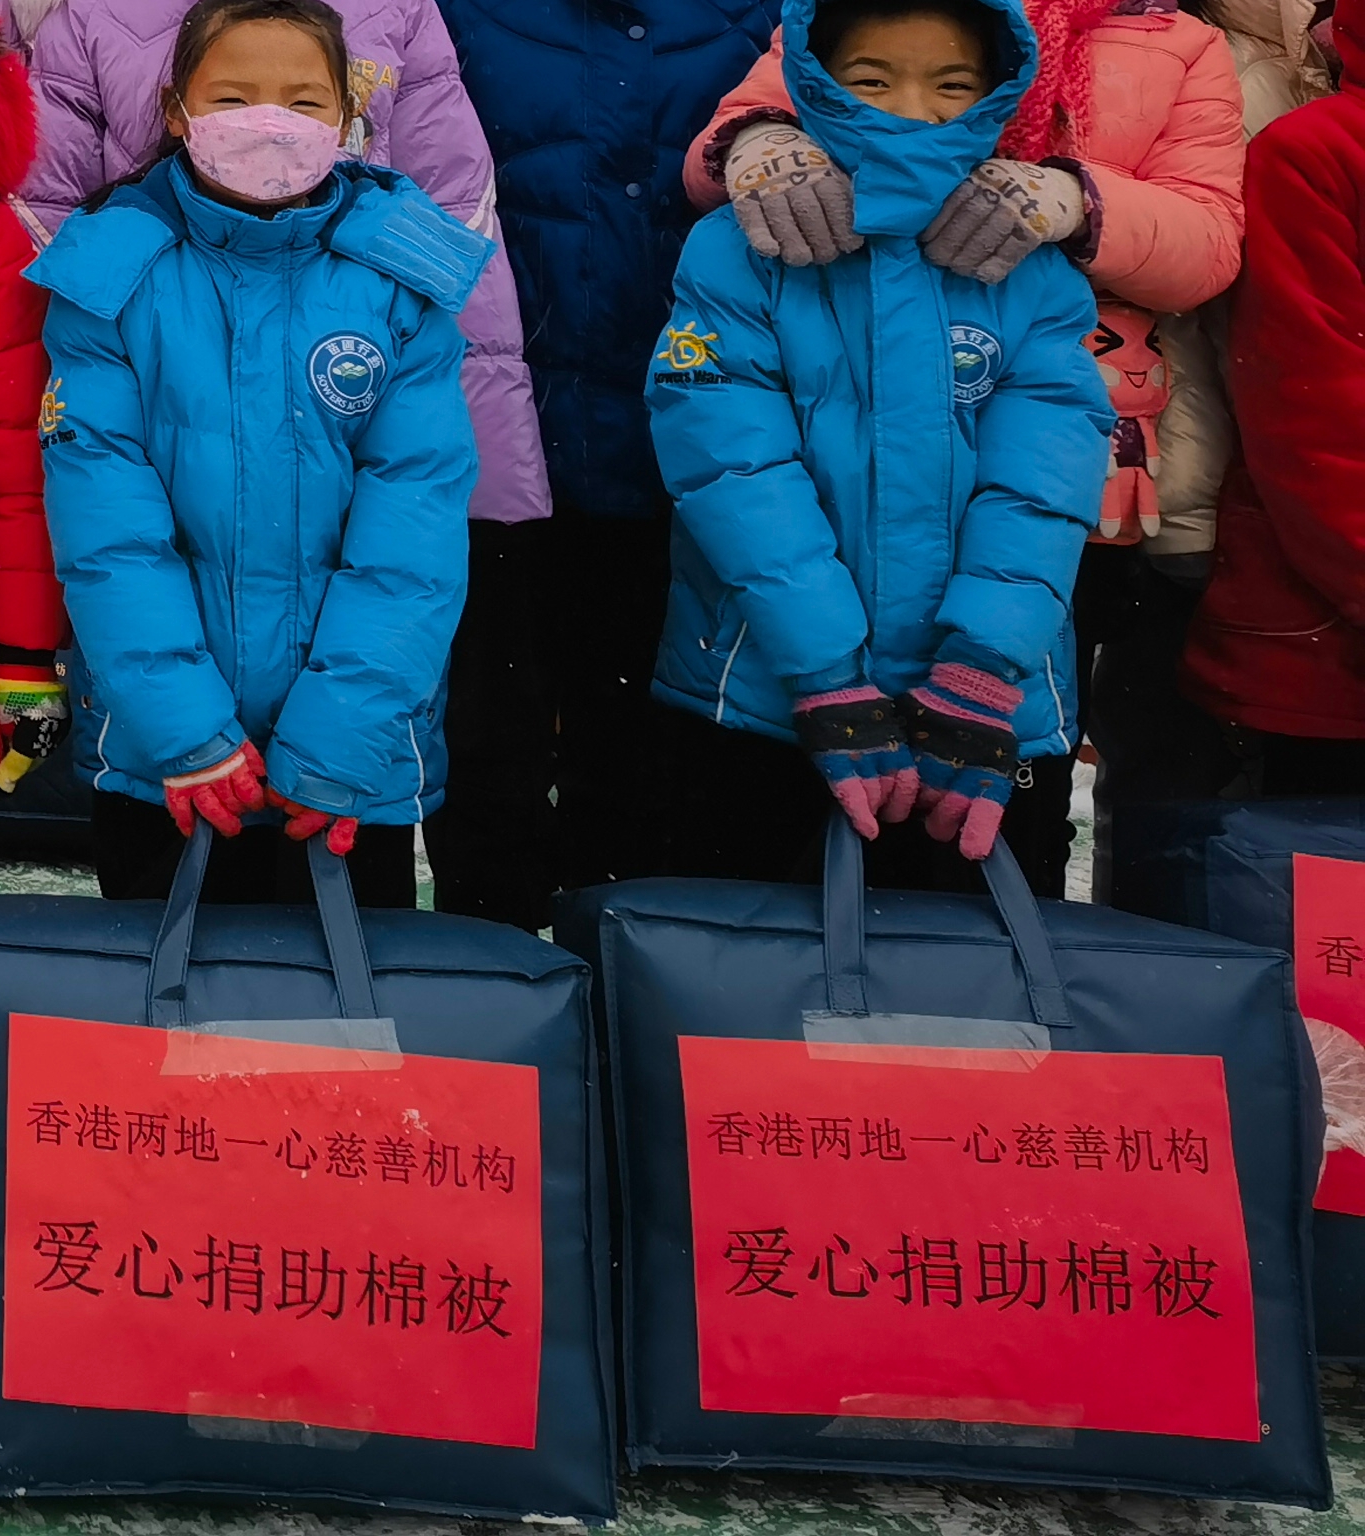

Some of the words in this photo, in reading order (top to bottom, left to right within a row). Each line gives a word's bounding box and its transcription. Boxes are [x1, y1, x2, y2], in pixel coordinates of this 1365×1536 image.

[316, 373, 348, 409] SOWERS
[346, 389, 375, 411] ACTION
[1315, 934, 1365, 978] 香
[26, 1099, 517, 1195] 香港两地一心慈善机构
[705, 1110, 1211, 1176] 香港两地一心慈善机构
[32, 1219, 514, 1340] 爱心捐助棉被
[721, 1224, 1225, 1322] 爱心捐助棉被
